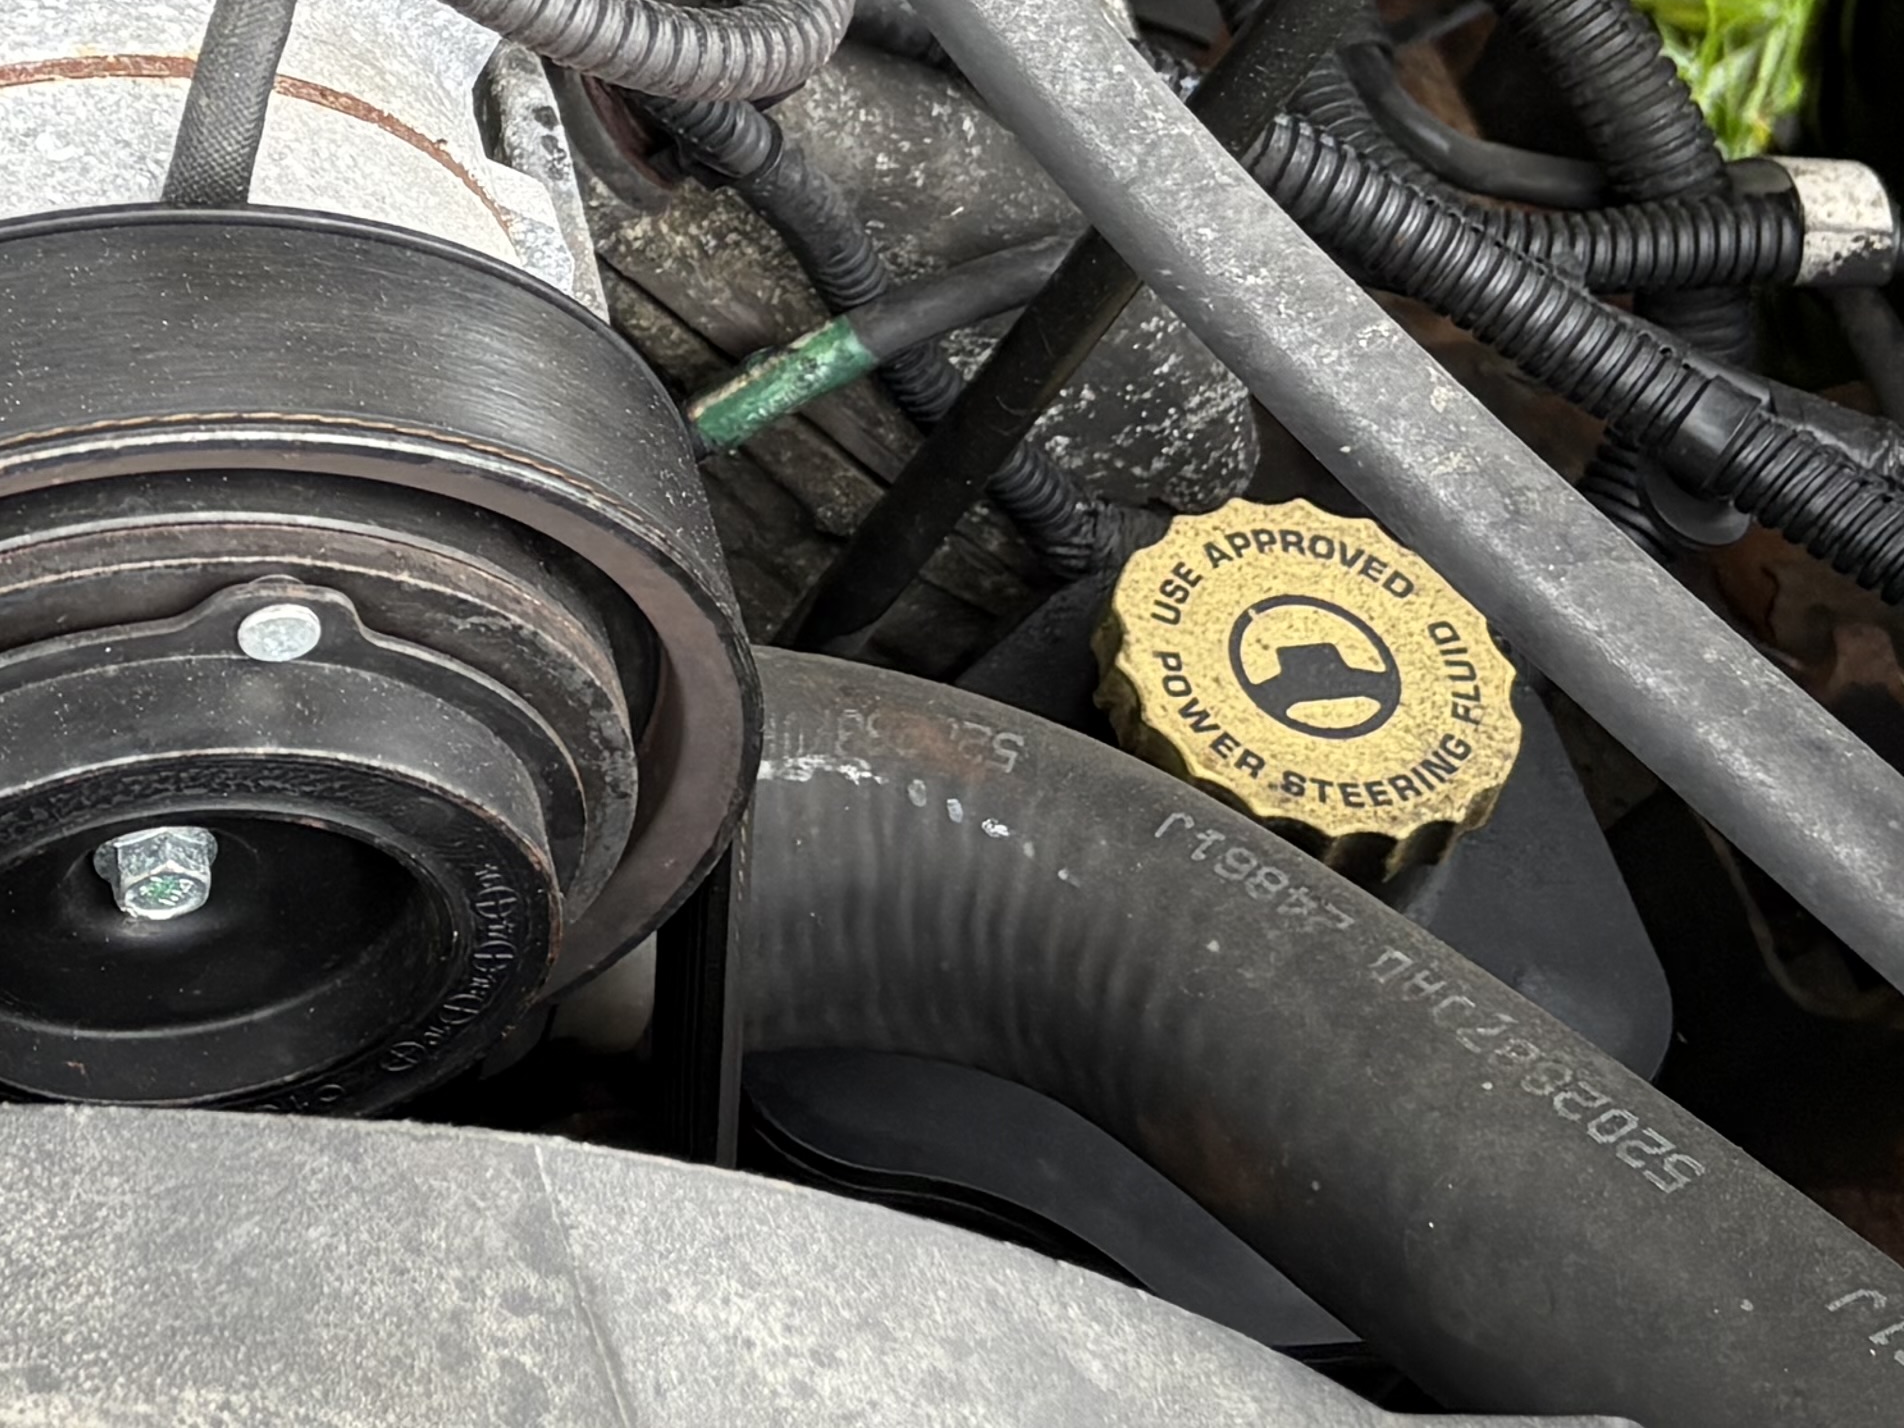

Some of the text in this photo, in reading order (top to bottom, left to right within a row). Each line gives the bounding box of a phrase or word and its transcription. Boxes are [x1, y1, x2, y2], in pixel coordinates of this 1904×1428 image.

[1152, 527, 1416, 627] USE APPROVED
[1152, 649, 1267, 779] POWER
[1275, 732, 1473, 809] STEERING
[1426, 620, 1482, 729] FLUID
